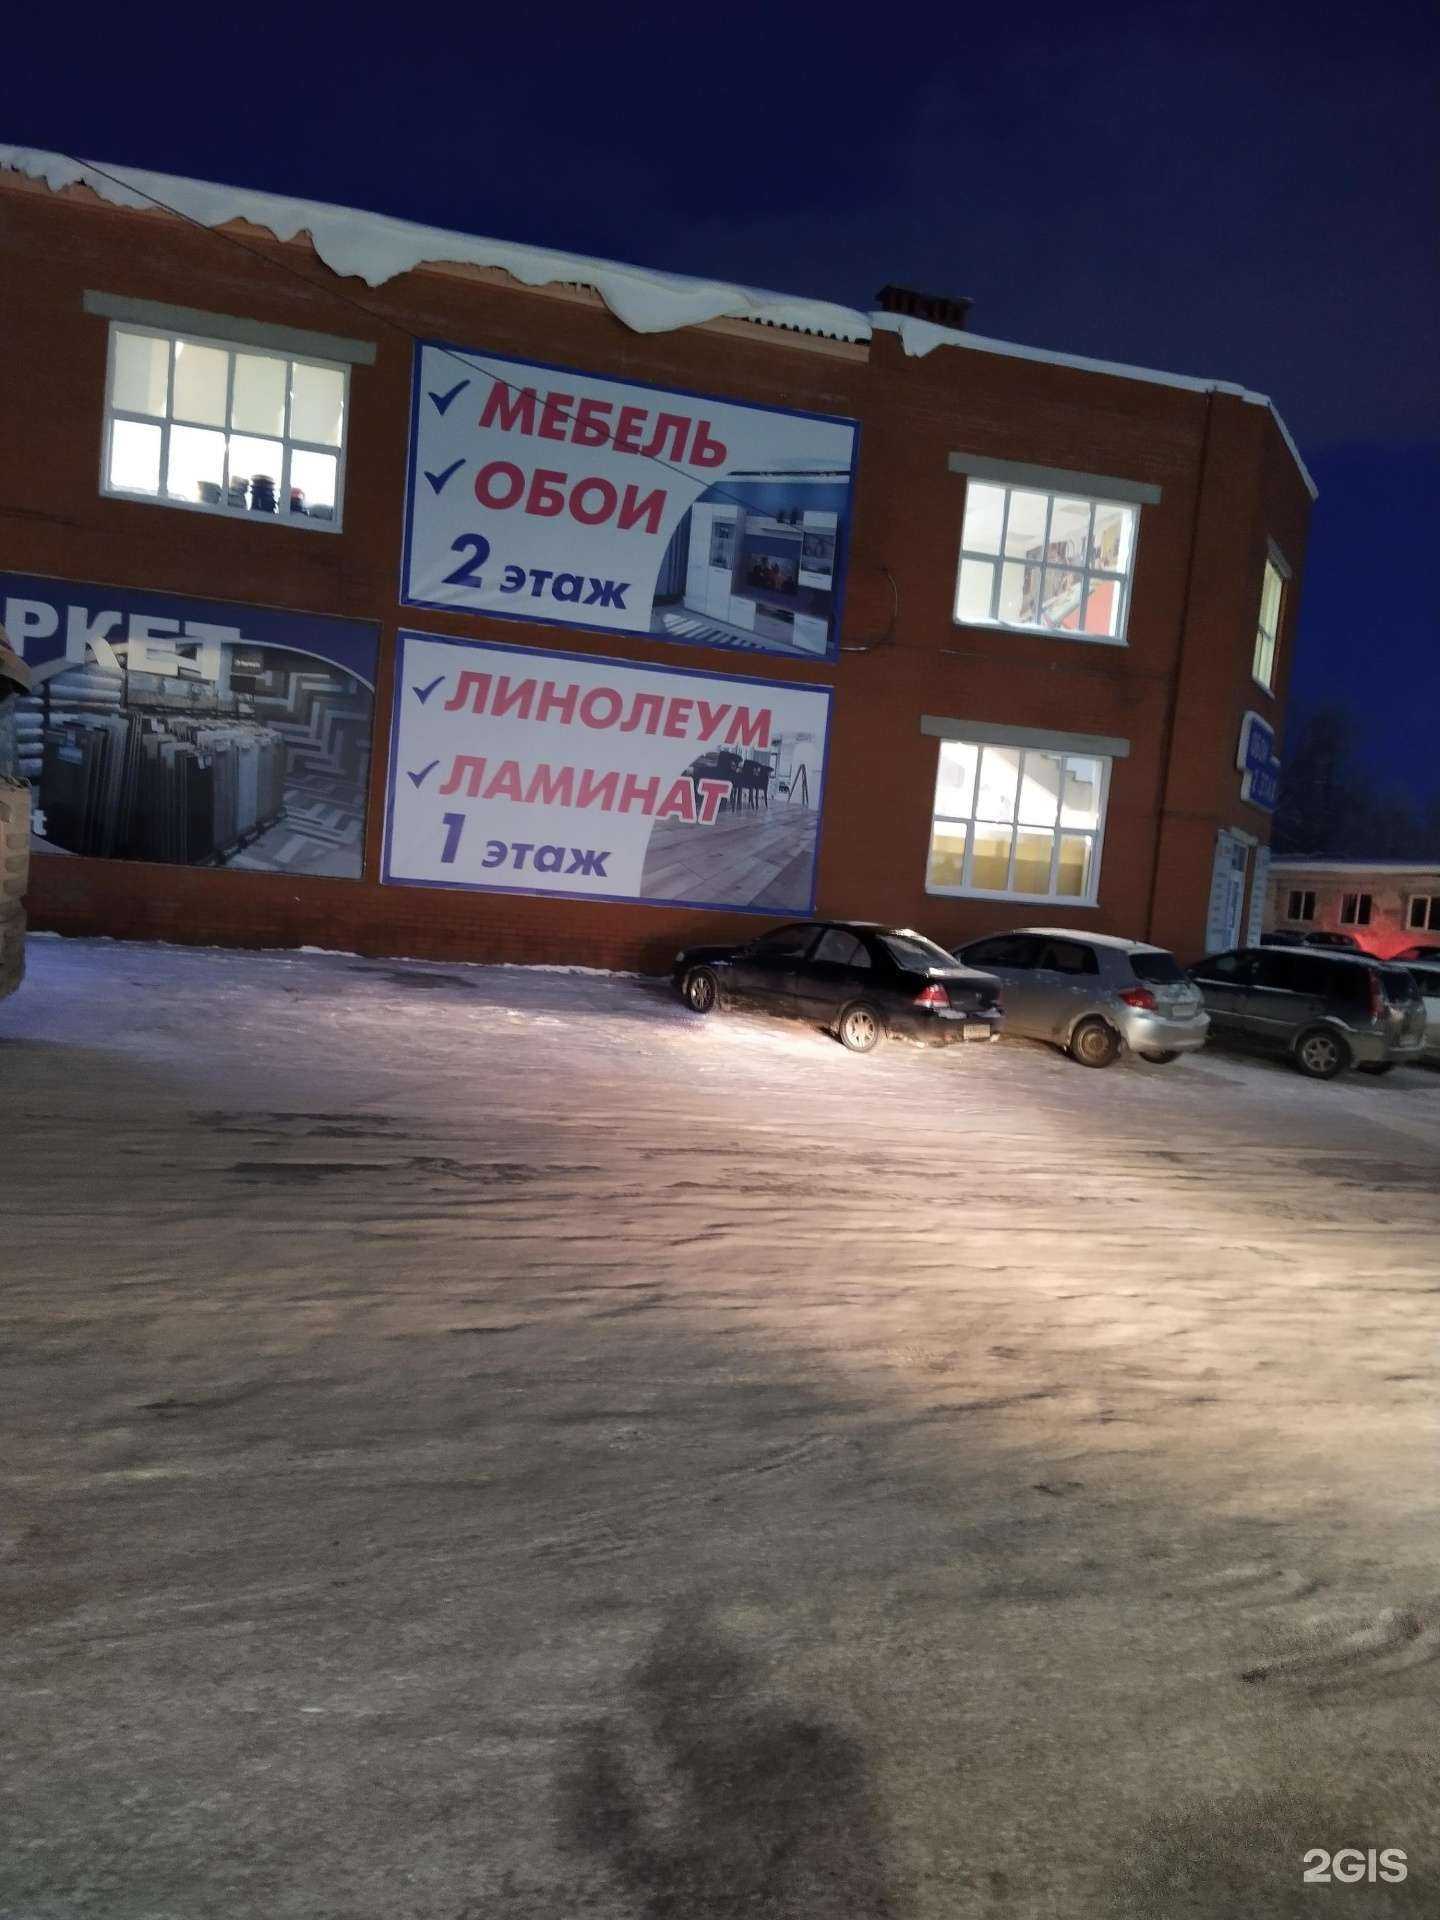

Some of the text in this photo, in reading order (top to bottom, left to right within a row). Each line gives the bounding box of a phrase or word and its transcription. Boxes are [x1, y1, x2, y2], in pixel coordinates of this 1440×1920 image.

[478, 380, 728, 468] МЕБЕЛЬ
[474, 461, 667, 535] ОБОИ
[442, 532, 631, 610] 2 этаж
[444, 670, 773, 749] ЛИНОЛЕУМ
[440, 754, 732, 825] ЛАМИНАТ
[440, 811, 611, 878] 1 этаж
